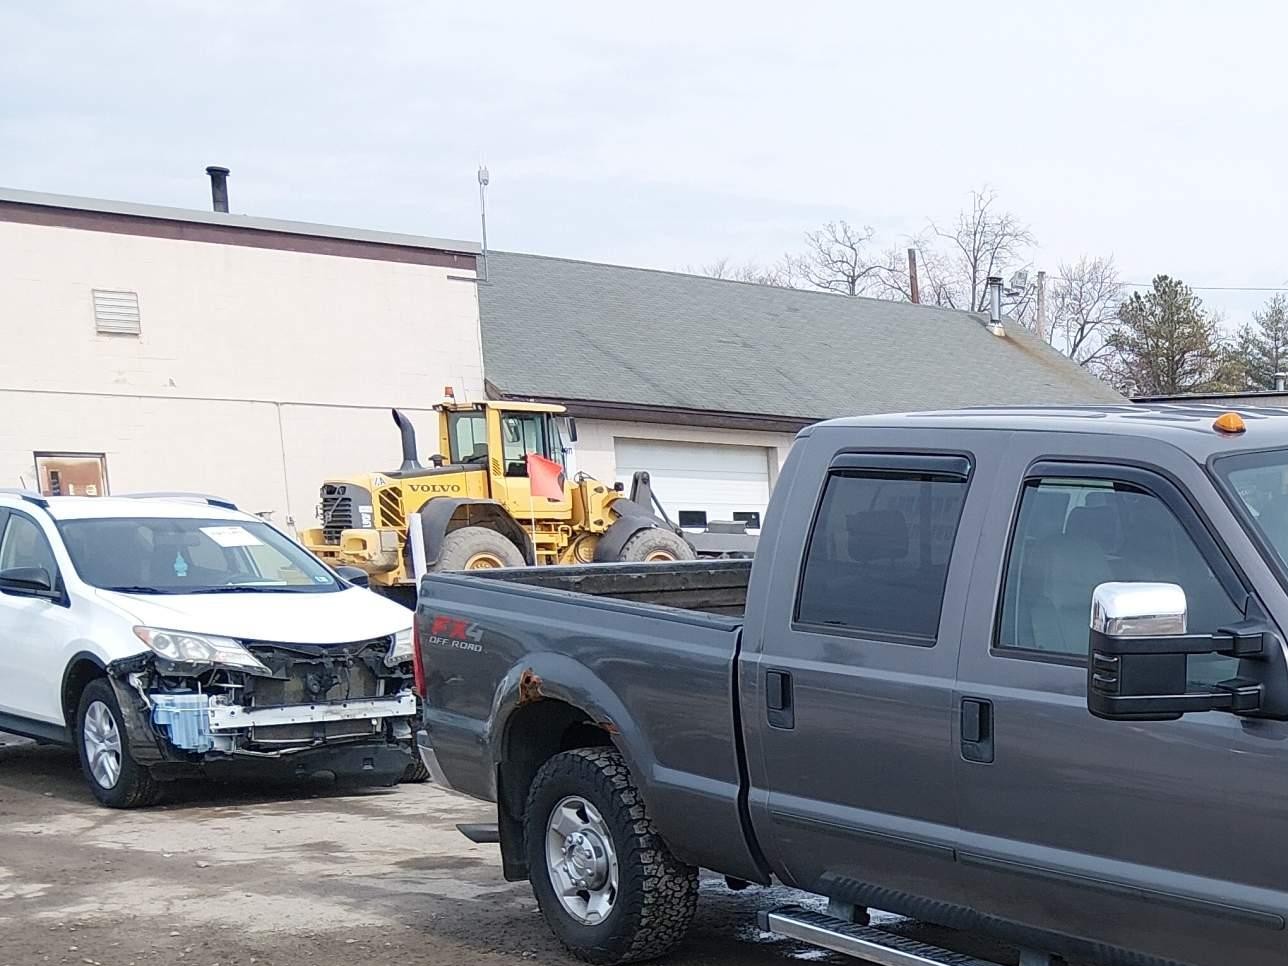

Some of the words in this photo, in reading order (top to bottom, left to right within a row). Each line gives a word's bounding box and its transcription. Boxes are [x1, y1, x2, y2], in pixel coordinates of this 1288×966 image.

[408, 484, 461, 493] VOLVO
[431, 614, 484, 641] FX4
[429, 636, 449, 646] OFF
[451, 640, 483, 652] ROAD
